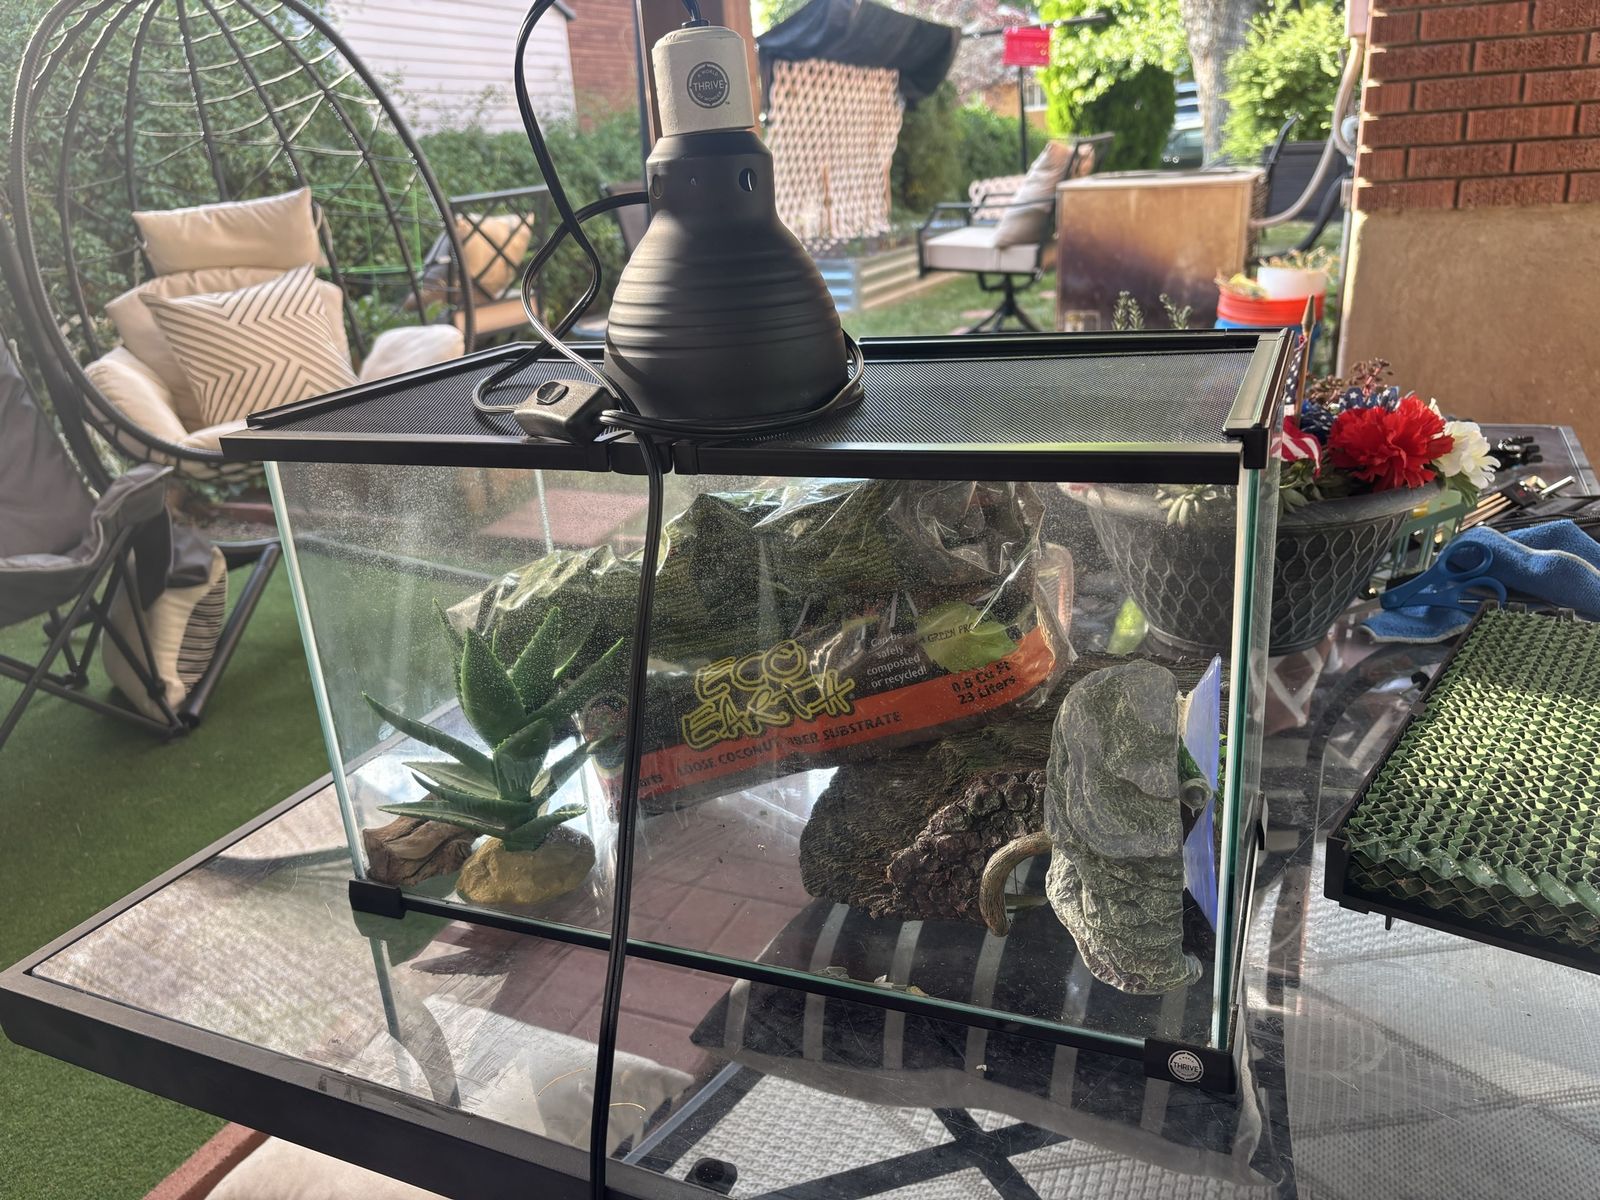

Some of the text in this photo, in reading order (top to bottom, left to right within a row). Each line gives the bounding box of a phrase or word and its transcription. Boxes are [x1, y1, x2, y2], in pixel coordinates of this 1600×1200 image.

[692, 80, 724, 92] THRIVE
[870, 632, 904, 648] Can be
[877, 644, 905, 659] safely
[695, 639, 807, 703] ECO
[866, 653, 921, 676] composted
[871, 666, 928, 688] or recycled!
[951, 677, 974, 693] 0.8
[975, 669, 995, 684] Cu
[957, 675, 1016, 705] 23 Liters
[682, 669, 855, 749] EARTH
[822, 710, 903, 741] SUBSTRATE
[1173, 1061, 1200, 1073] THRIVE
